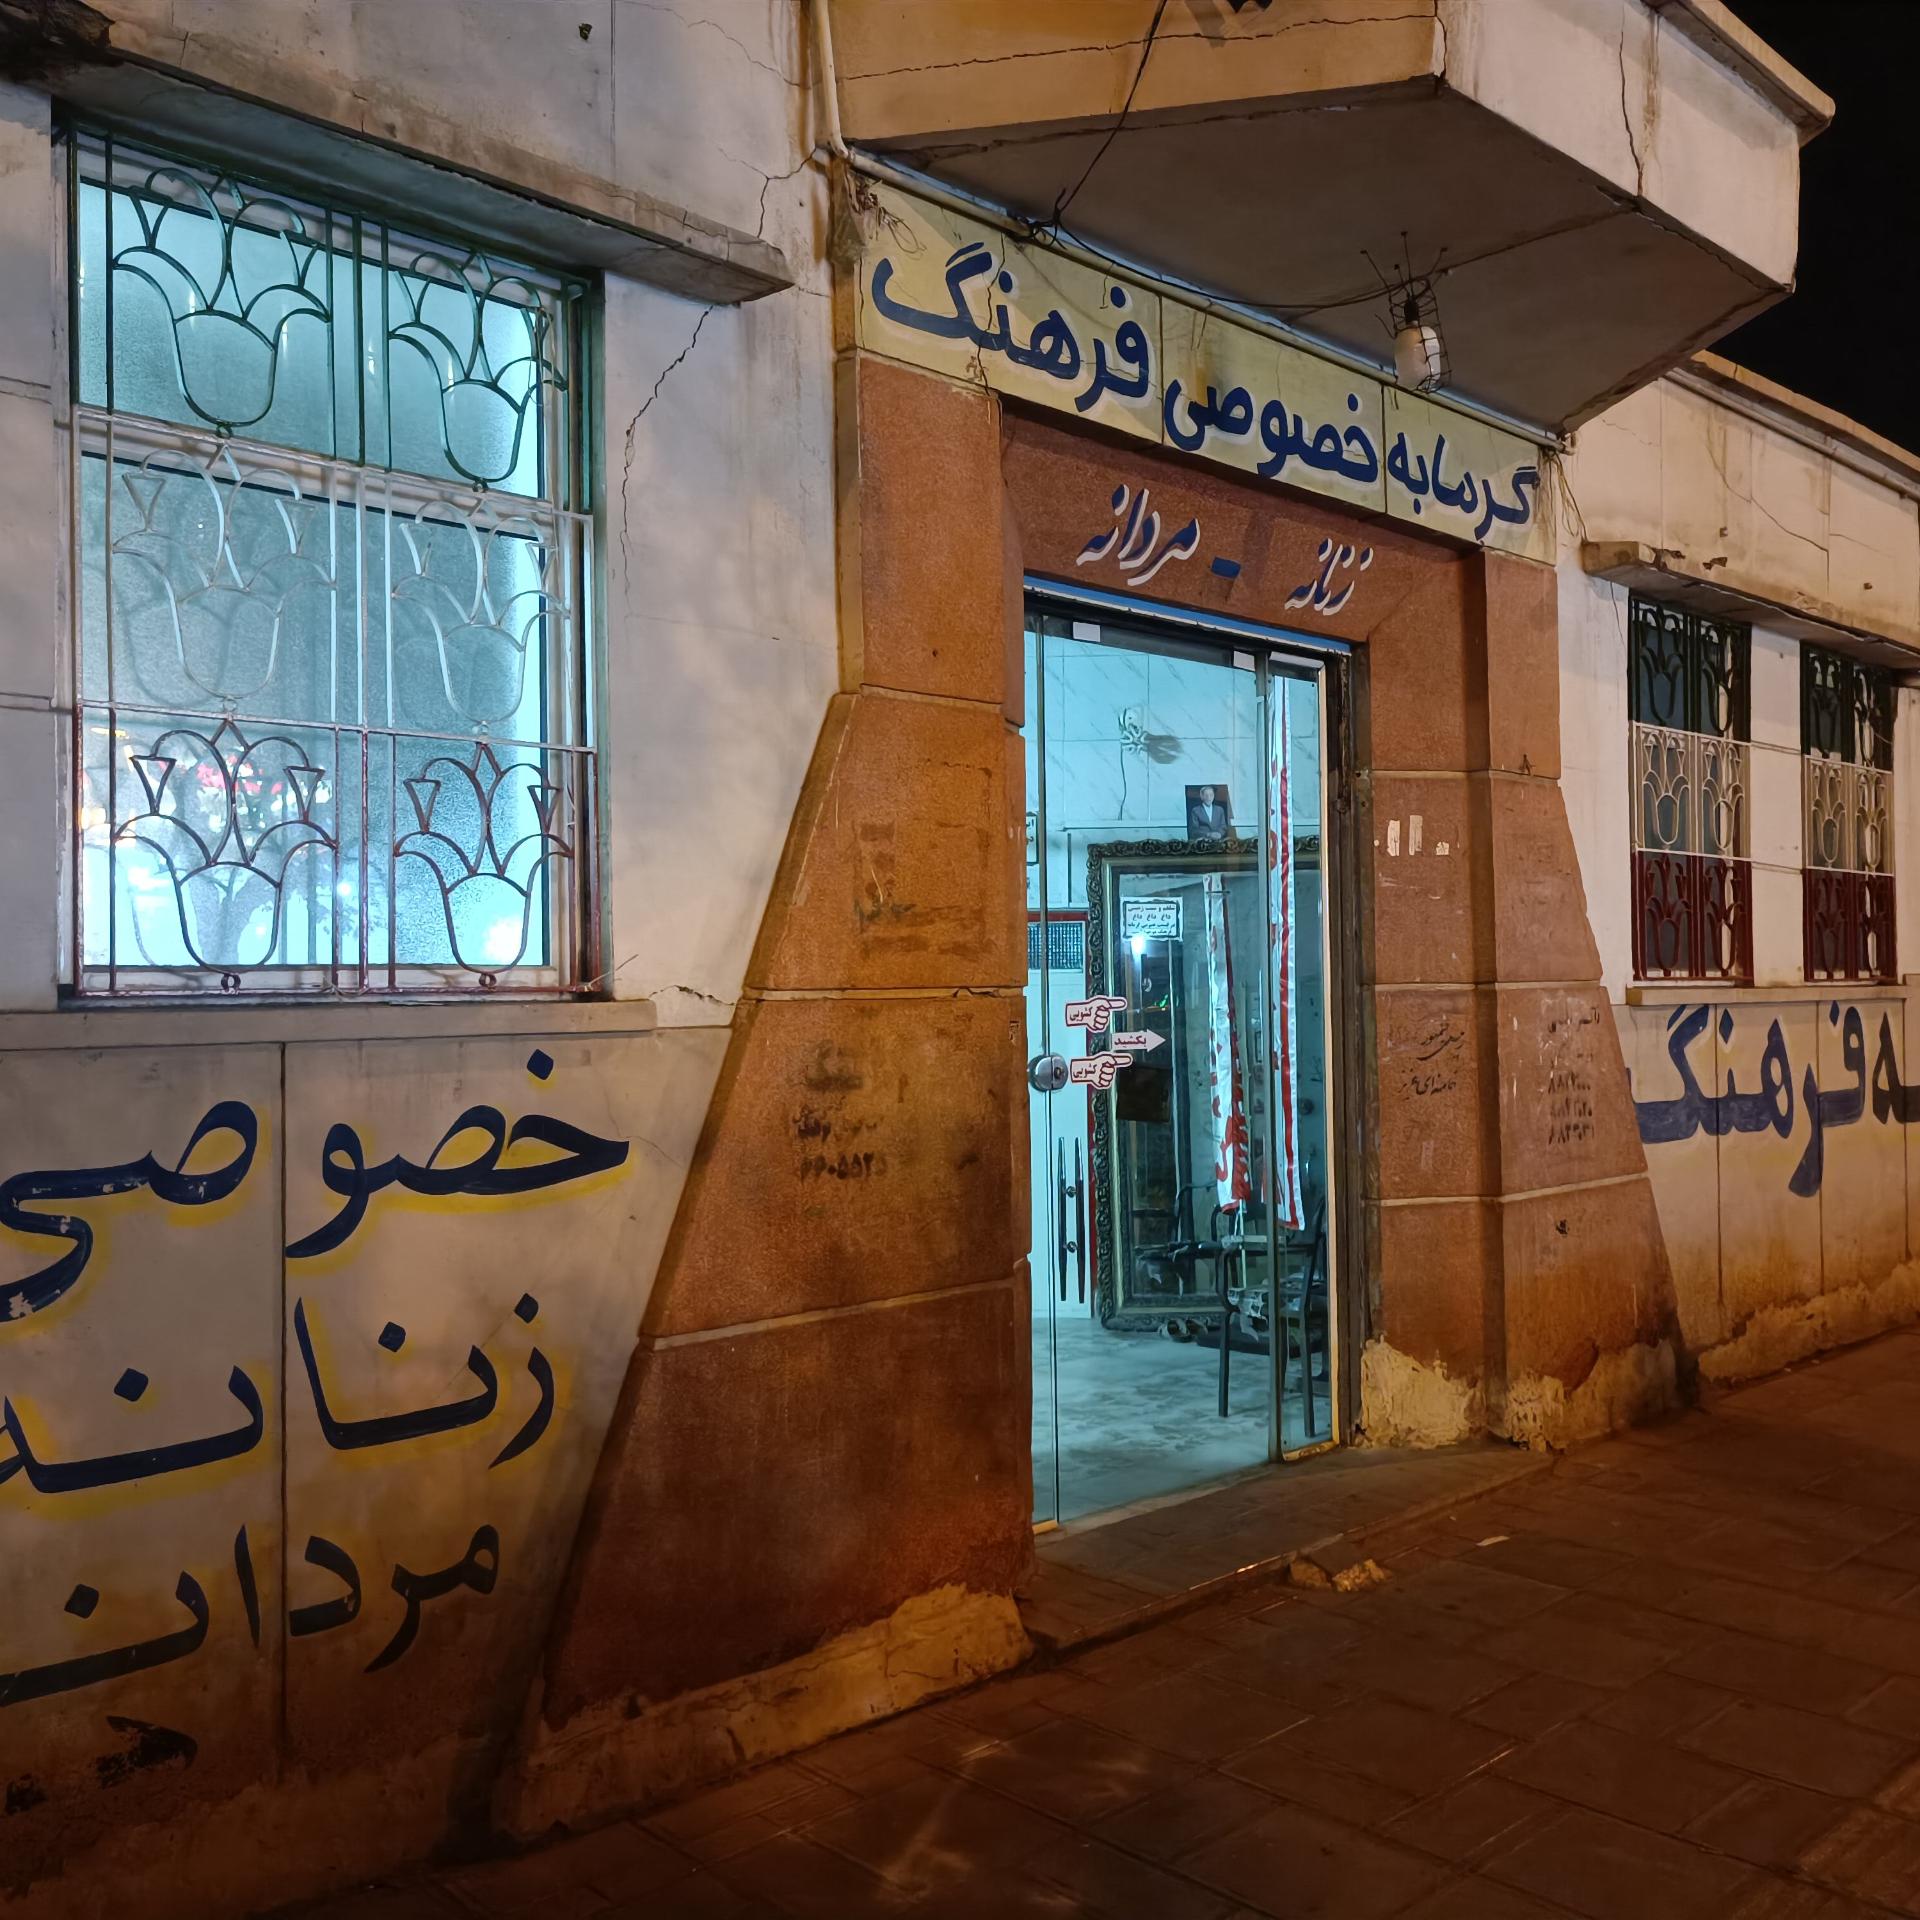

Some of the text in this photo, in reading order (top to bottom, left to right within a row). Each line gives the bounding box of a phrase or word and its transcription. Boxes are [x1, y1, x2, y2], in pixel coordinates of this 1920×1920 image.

[871, 241, 1538, 541] گرمابه خصوصی فرهنگ
[1076, 484, 1372, 616] زنانه مردانه
[1114, 1035, 1147, 1049] بکشید
[1625, 1000, 1866, 1198] فرهنگ
[0, 1048, 630, 1323] خصوصی
[0, 1523, 499, 1703] مردان
